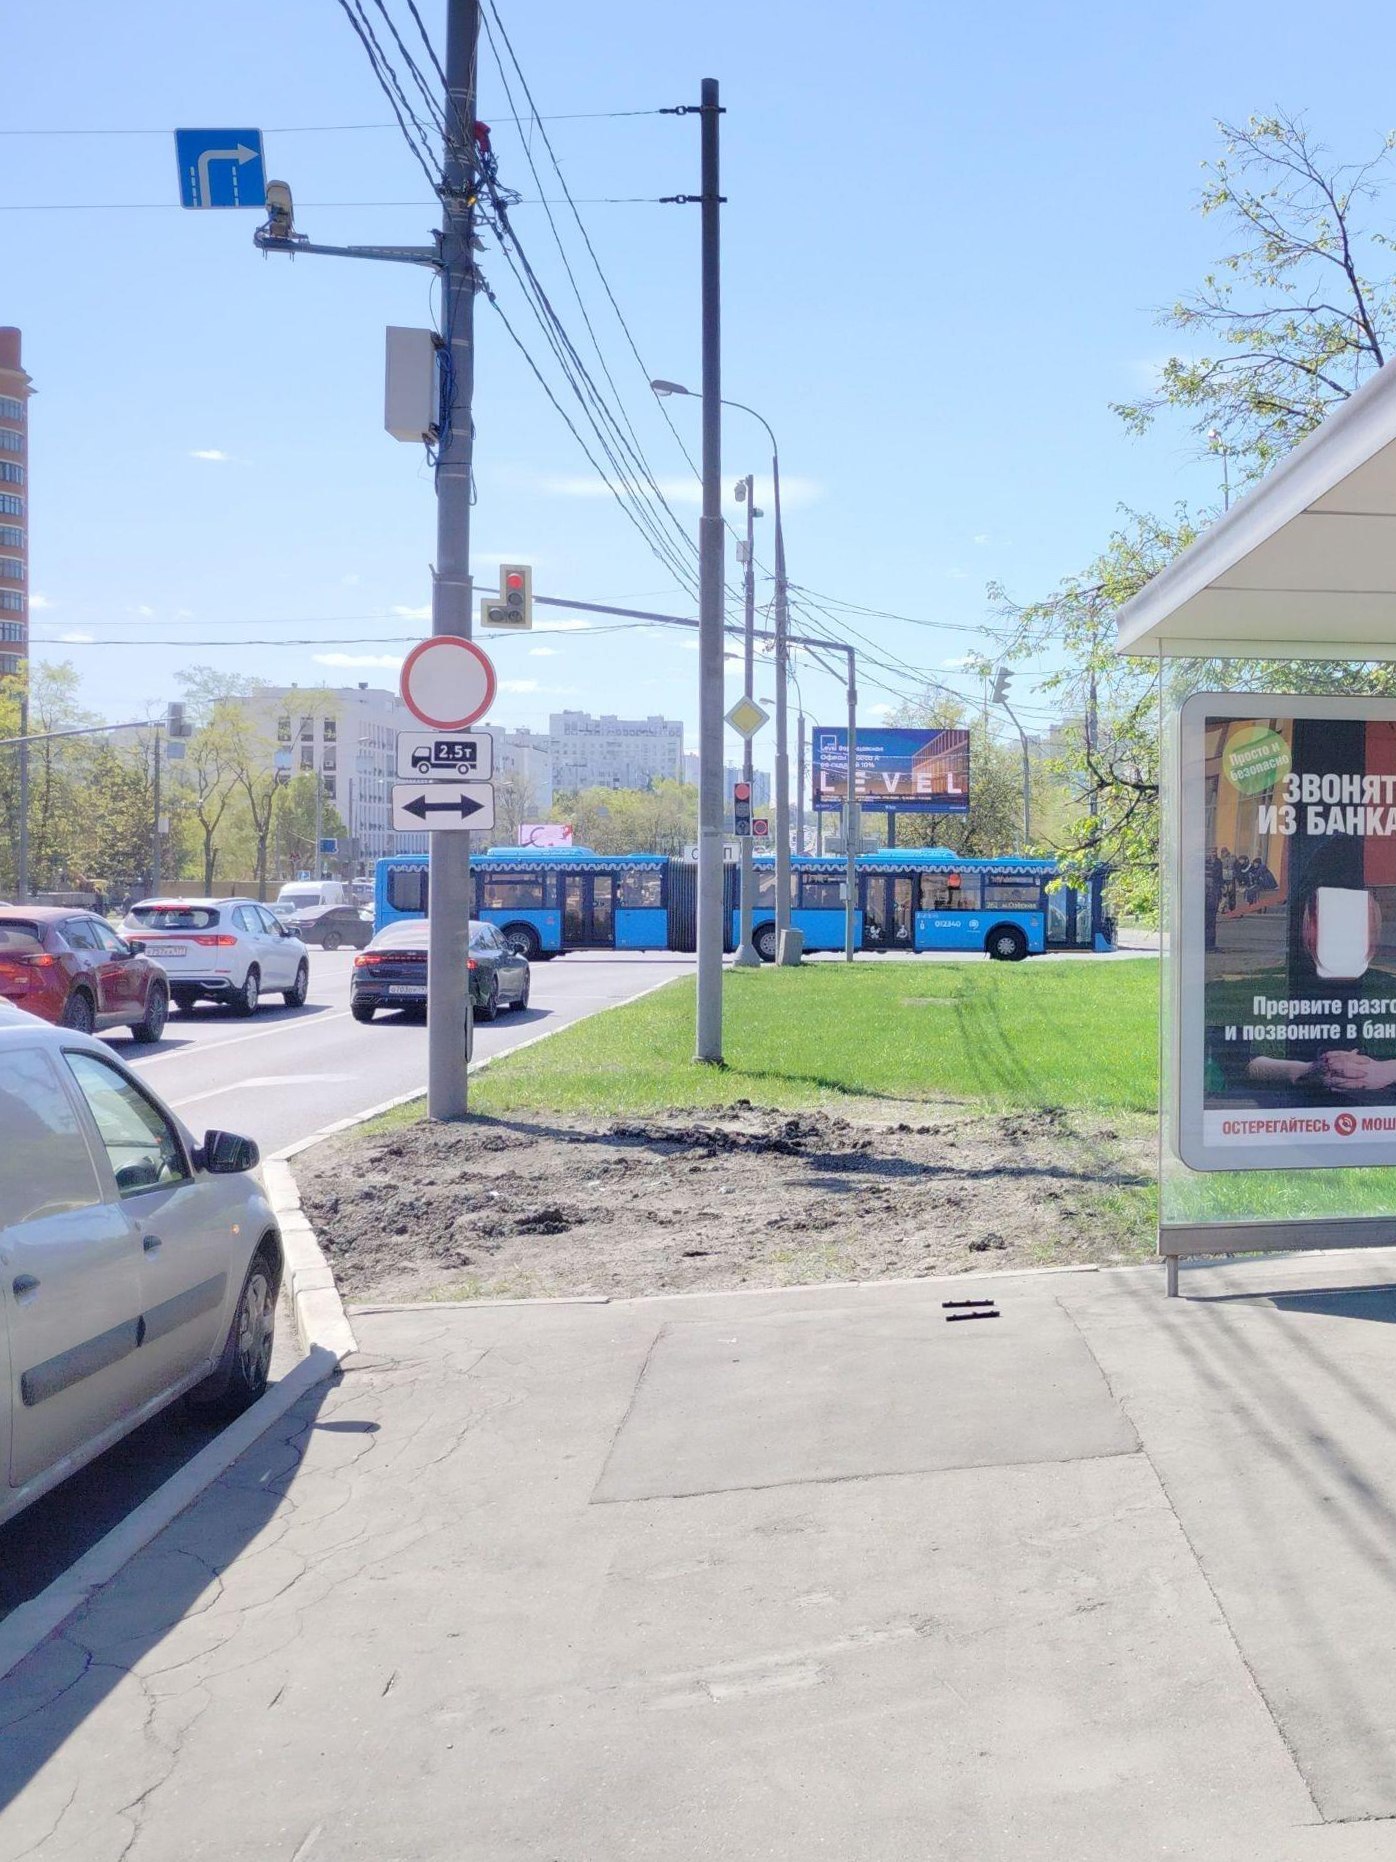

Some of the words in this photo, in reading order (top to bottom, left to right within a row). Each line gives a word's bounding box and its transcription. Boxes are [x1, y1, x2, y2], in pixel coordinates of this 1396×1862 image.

[1229, 745, 1270, 767] Просто
[1271, 742, 1281, 753] и
[1231, 754, 1290, 781] безопасно
[820, 770, 962, 795] LEVEL
[1258, 804, 1297, 835] ИЗ
[1253, 996, 1342, 1019] Прервите
[1225, 1025, 1237, 1041] и
[1242, 1023, 1341, 1041] позвоните
[1346, 1024, 1357, 1039] в
[1222, 1117, 1331, 1135] ОСТЕРЕГАЙТЕСЬ
